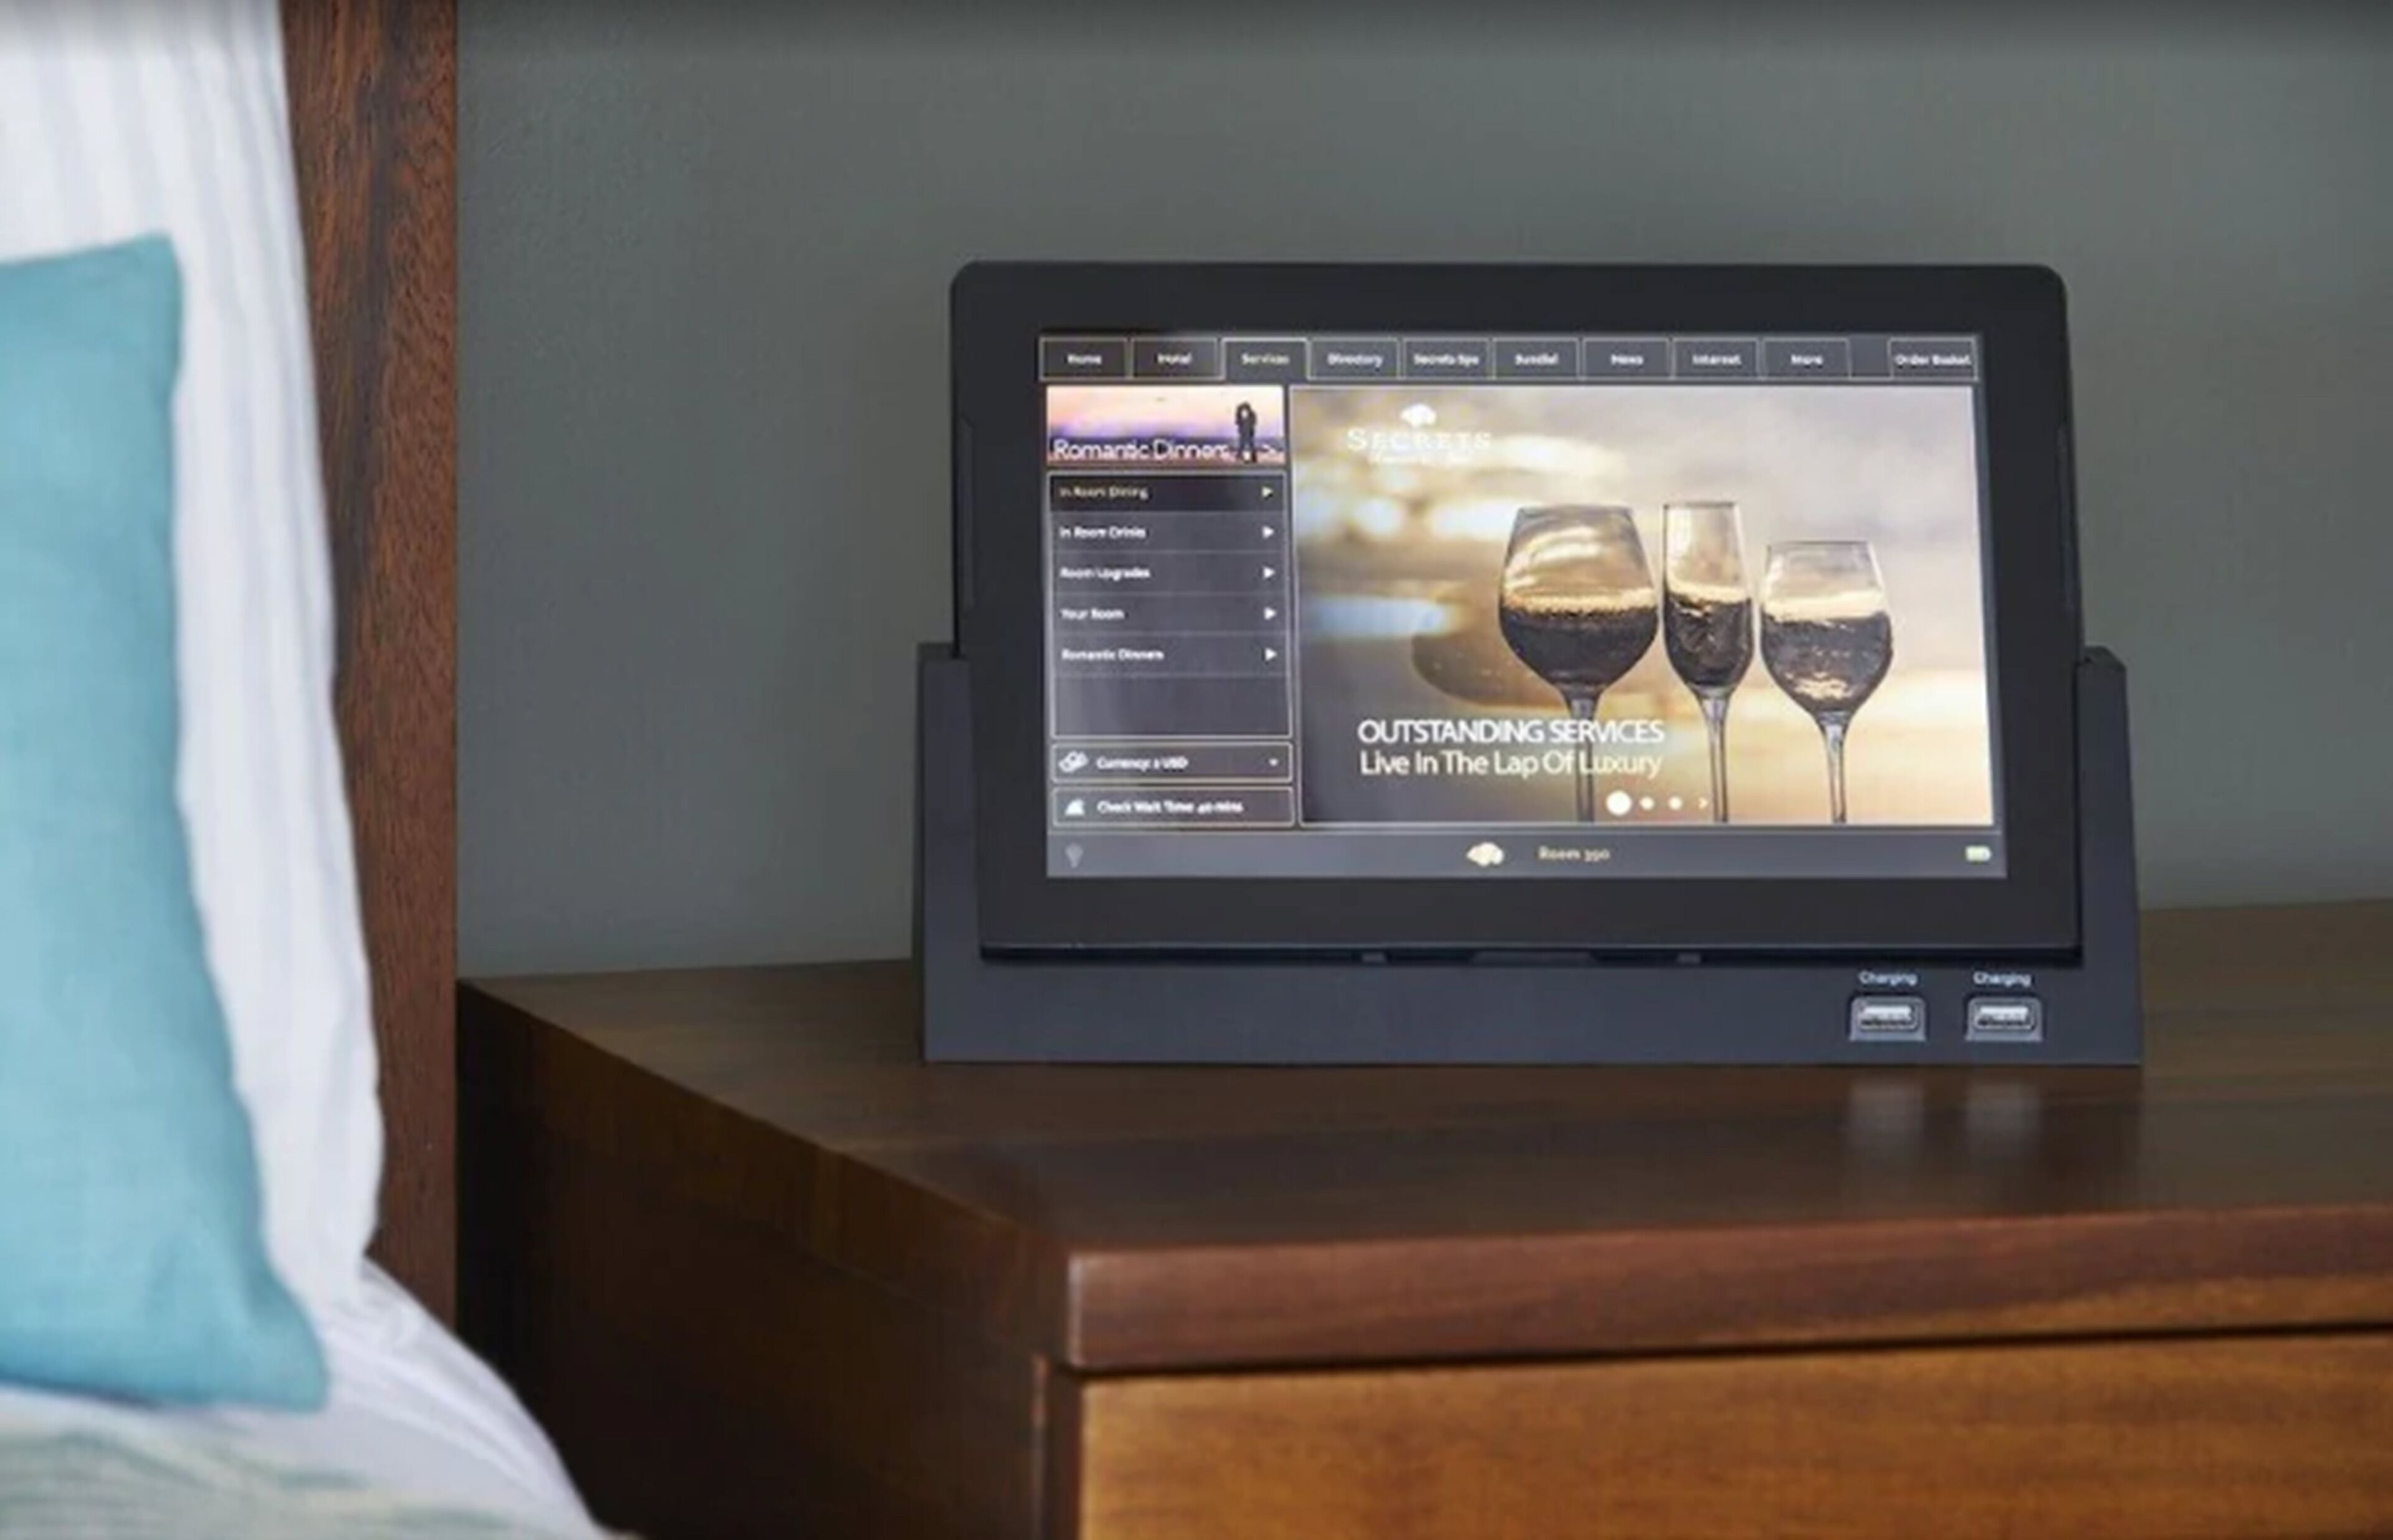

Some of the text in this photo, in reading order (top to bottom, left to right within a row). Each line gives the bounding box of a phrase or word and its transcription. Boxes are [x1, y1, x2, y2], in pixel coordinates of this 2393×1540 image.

[1242, 353, 1289, 365] Services
[1327, 353, 1382, 368] Directory
[1053, 439, 1150, 460] Romantic
[1074, 486, 1106, 497] Room
[1109, 486, 1148, 500] Dining
[1060, 526, 1071, 538] In
[1074, 526, 1106, 538] Room
[1061, 568, 1095, 579] Room
[1061, 609, 1125, 620] Your Room
[1062, 649, 1164, 662] Romantic Dinners
[1357, 719, 1665, 744] OUTSTANDING SERVICES
[1360, 749, 1663, 779] Live In The Lap Of Luxury
[1539, 845, 1581, 860] Room
[1859, 971, 1918, 986] Charging
[1973, 971, 2032, 987] Charging
